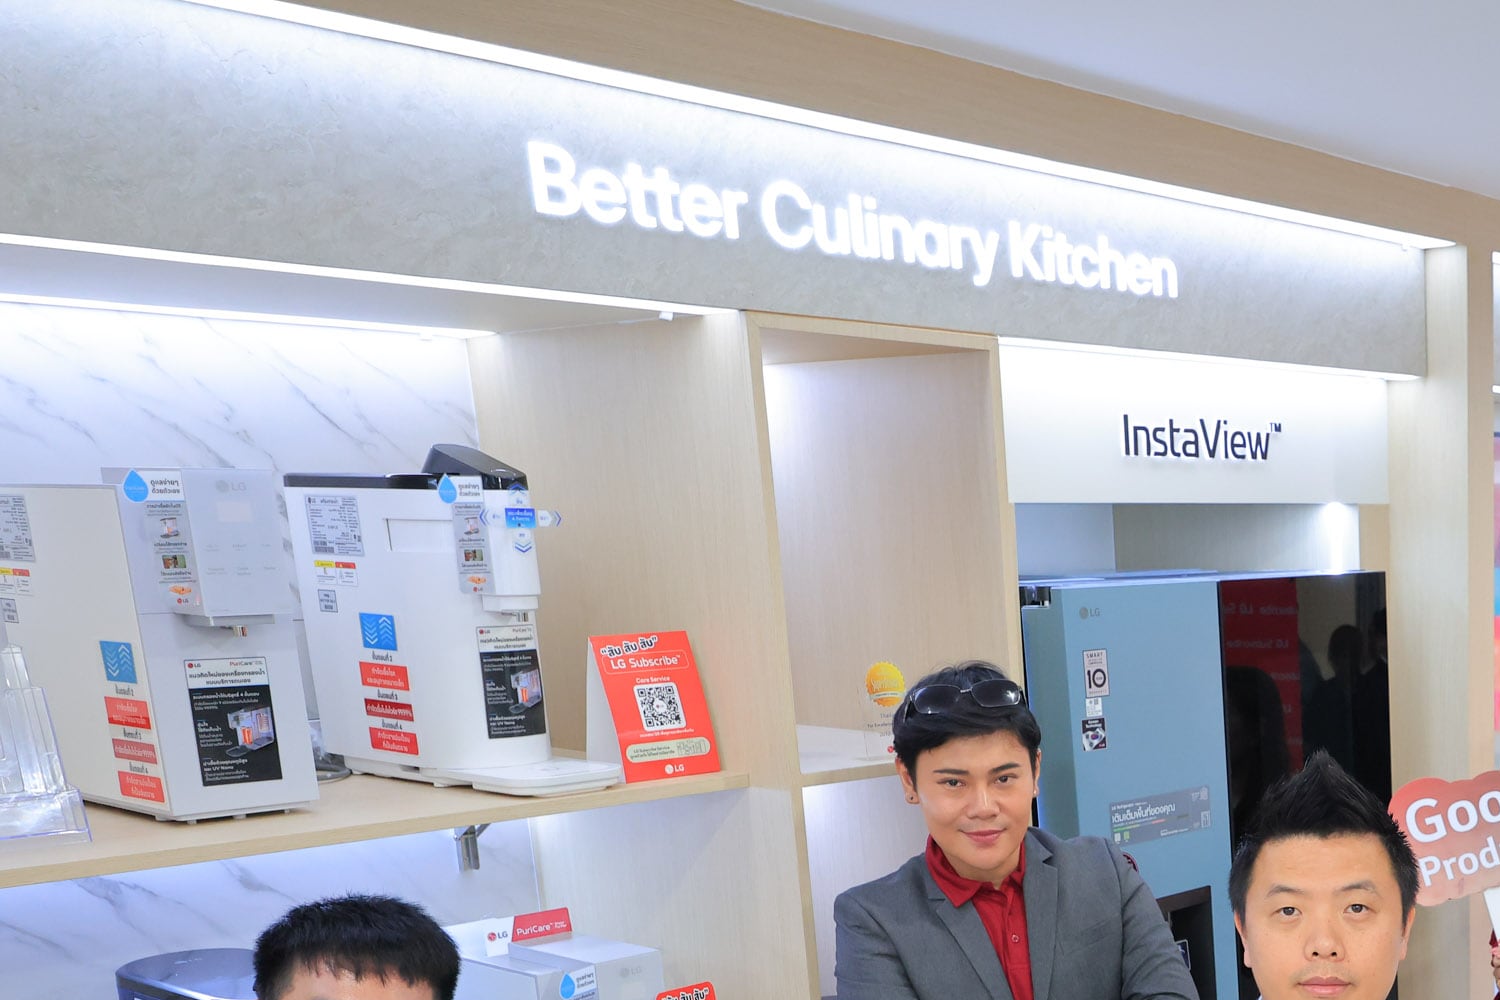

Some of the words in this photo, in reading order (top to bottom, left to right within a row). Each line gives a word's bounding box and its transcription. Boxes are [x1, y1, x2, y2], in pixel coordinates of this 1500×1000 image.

[526, 141, 748, 239] Better
[760, 179, 999, 287] Culinary
[1007, 220, 1178, 298] Kitchen
[610, 659, 627, 669] LG
[1087, 669, 1106, 689] 10
[674, 764, 685, 772] LG
[498, 931, 508, 939] LG
